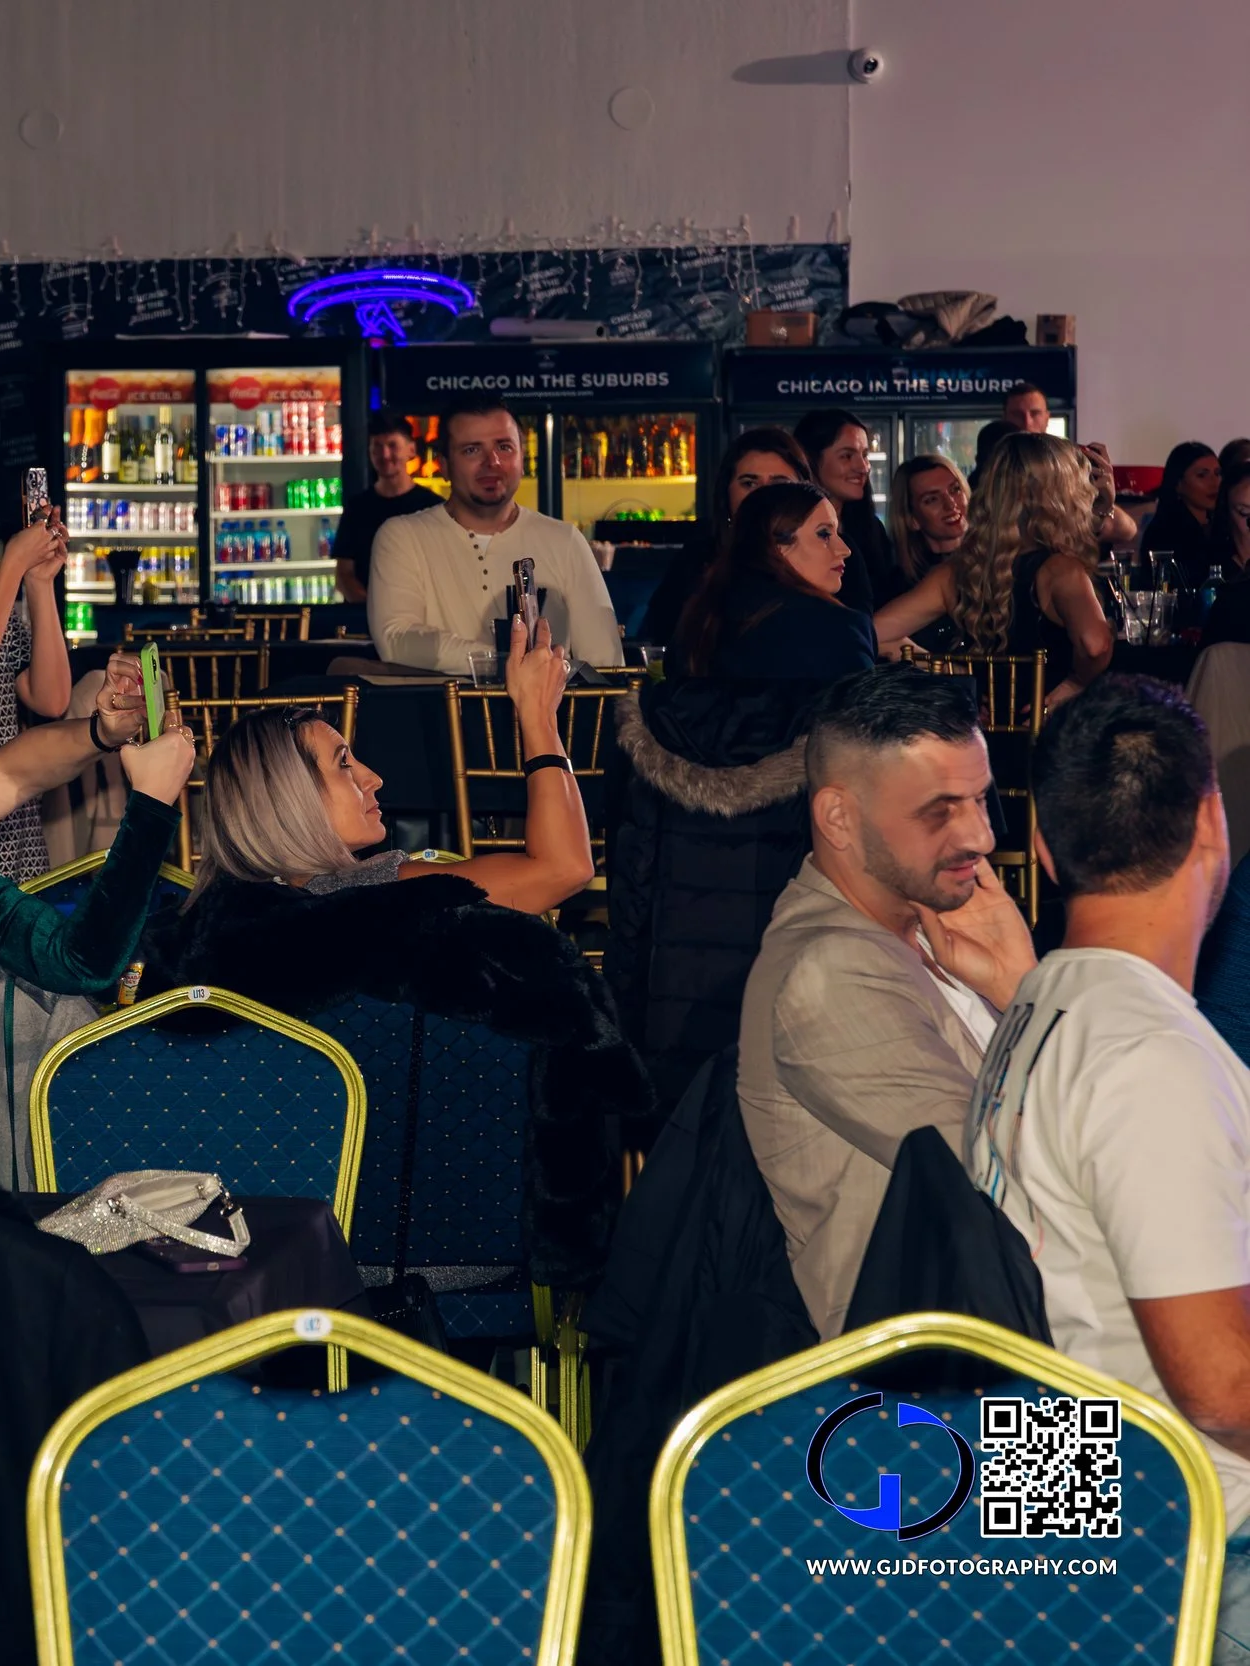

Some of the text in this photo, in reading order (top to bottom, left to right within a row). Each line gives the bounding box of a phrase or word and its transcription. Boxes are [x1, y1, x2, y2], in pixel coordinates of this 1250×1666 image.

[426, 372, 670, 390] CHICAGO IN THE SUBURBS
[777, 379, 863, 394] CHICAGO
[869, 379, 888, 393] IN
[893, 379, 930, 393] THE
[268, 389, 324, 400] ICE COLD
